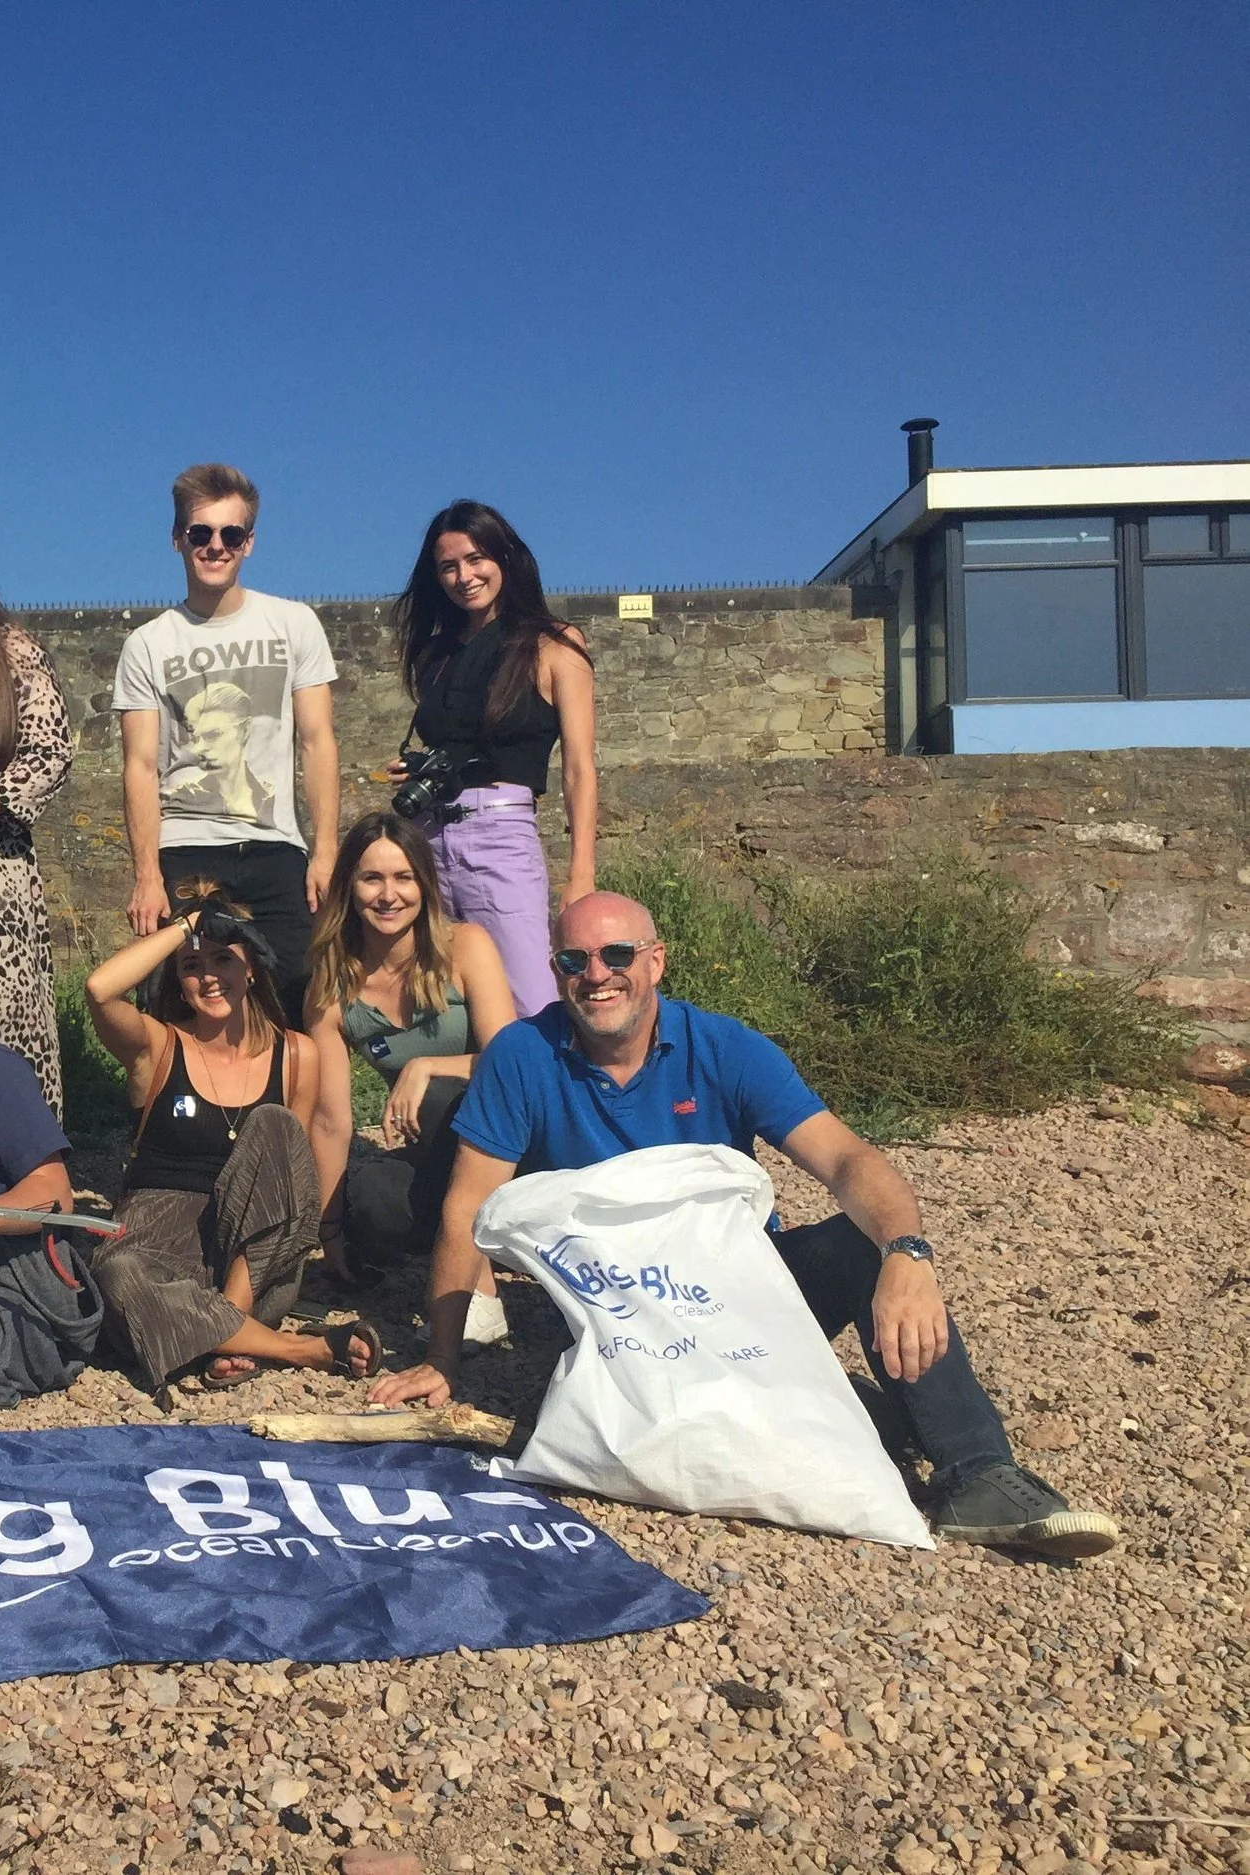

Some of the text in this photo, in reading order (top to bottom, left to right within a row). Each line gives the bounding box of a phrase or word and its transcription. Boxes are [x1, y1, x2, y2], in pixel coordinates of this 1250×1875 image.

[163, 639, 288, 685] BOWIE
[640, 1265, 712, 1304] Blue
[673, 1302, 725, 1319] Cleaup
[613, 1336, 697, 1360] FOLLOW
[108, 1535, 321, 1568] ocean
